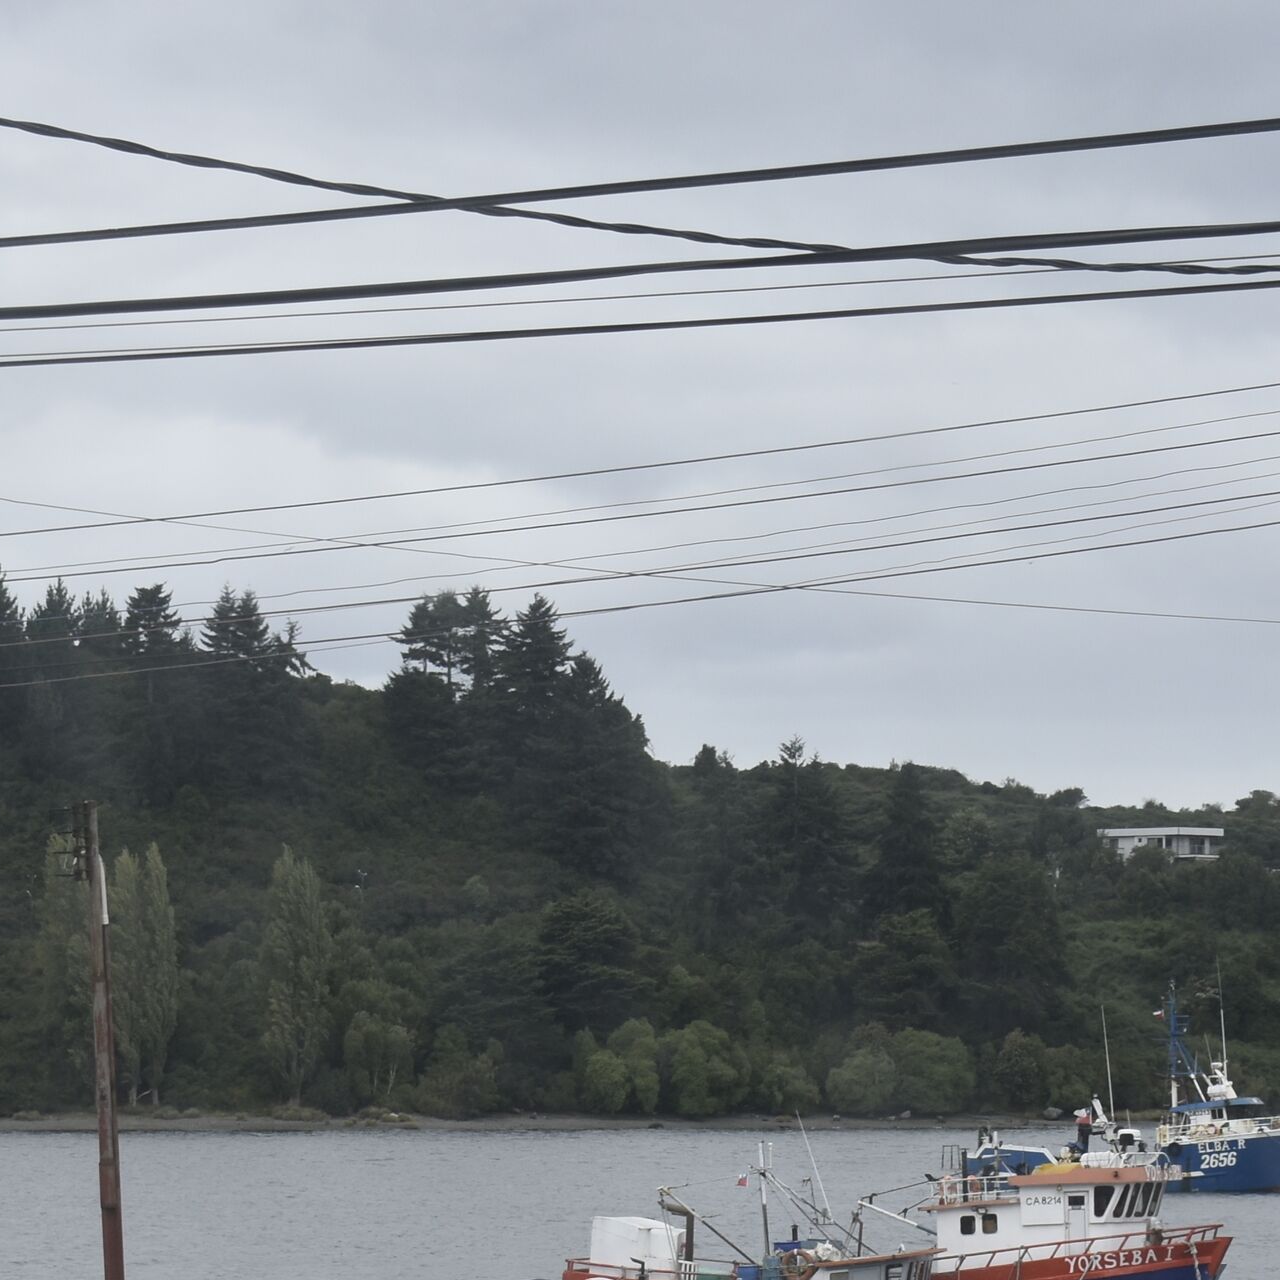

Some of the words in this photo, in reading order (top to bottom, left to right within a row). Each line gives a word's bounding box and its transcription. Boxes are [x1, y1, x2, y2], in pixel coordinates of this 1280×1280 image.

[1200, 1152, 1238, 1169] 2656
[1064, 1249, 1158, 1274] YORSEBA
[1164, 1246, 1174, 1261] I
